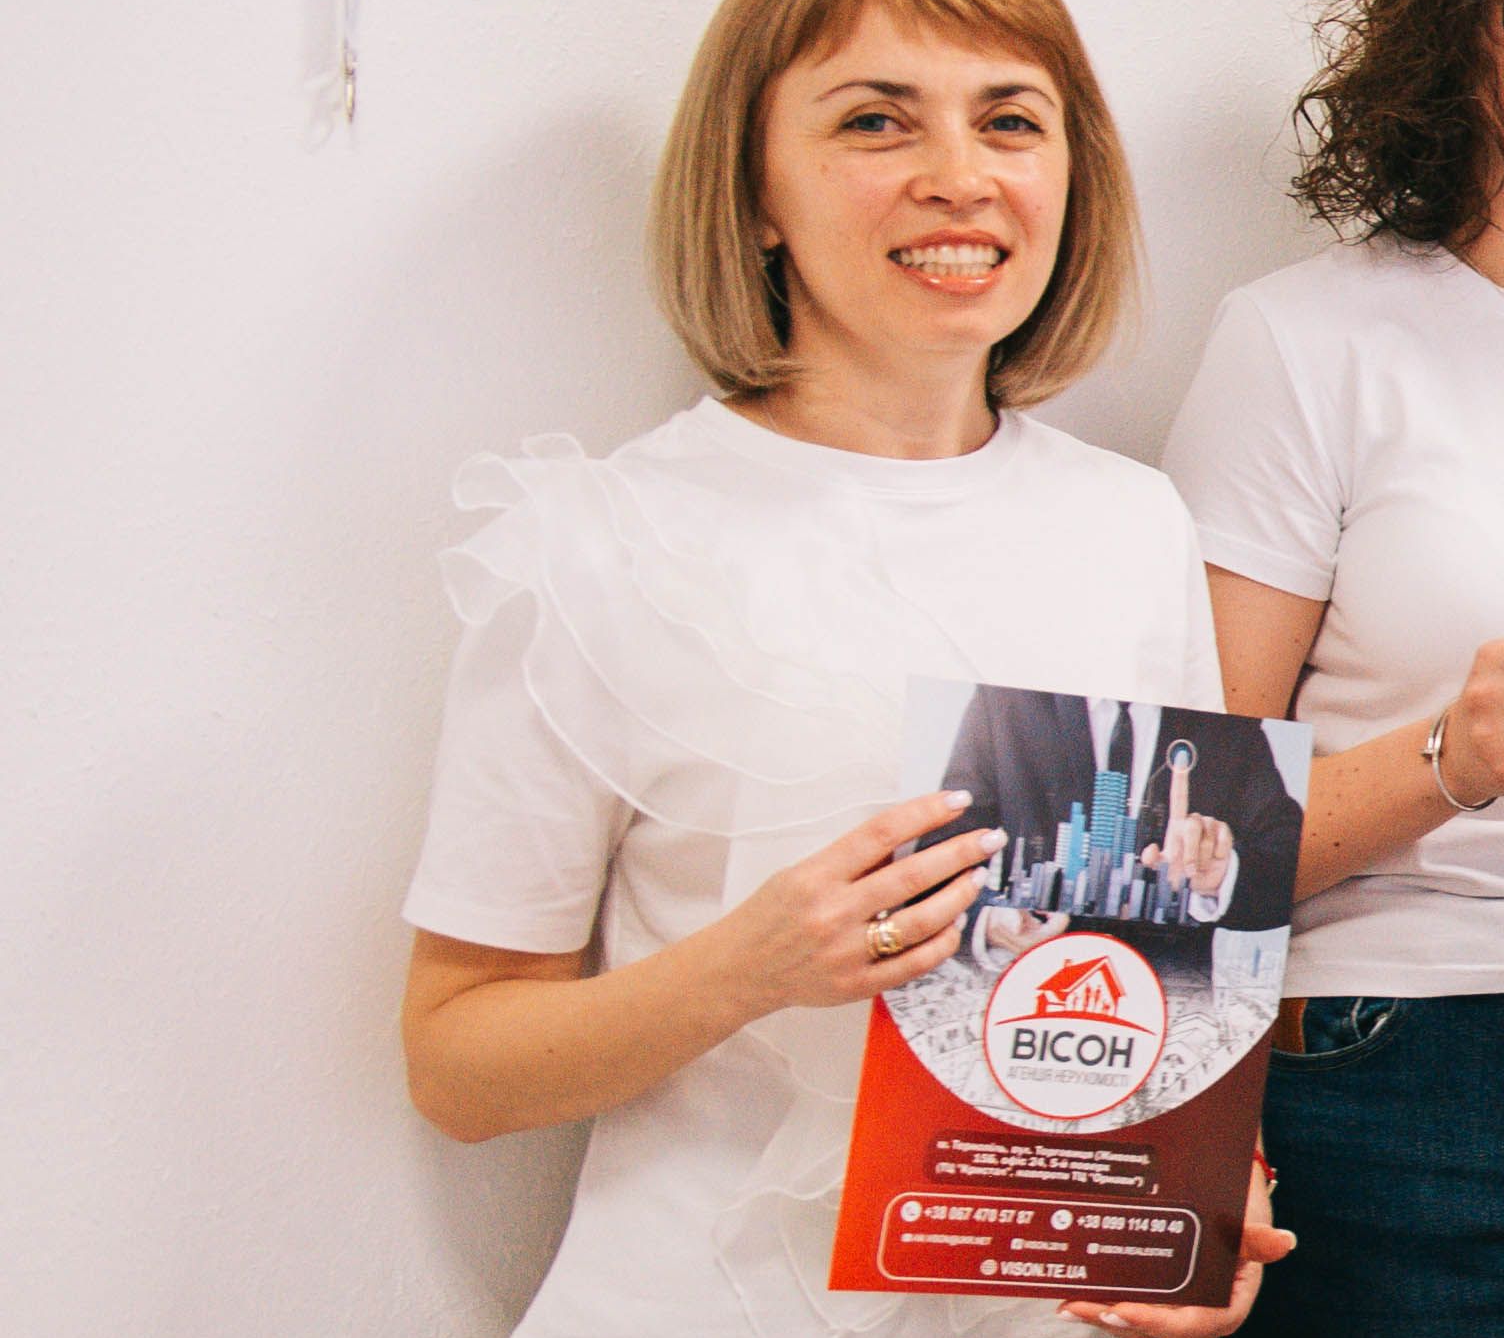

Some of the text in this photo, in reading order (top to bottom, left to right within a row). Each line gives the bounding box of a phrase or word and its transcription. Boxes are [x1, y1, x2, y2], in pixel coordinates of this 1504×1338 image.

[1010, 1028, 1135, 1068] ВІСОН
[1076, 1214, 1101, 1229] +38
[1001, 1261, 1087, 1279] VISON.TE.UA
